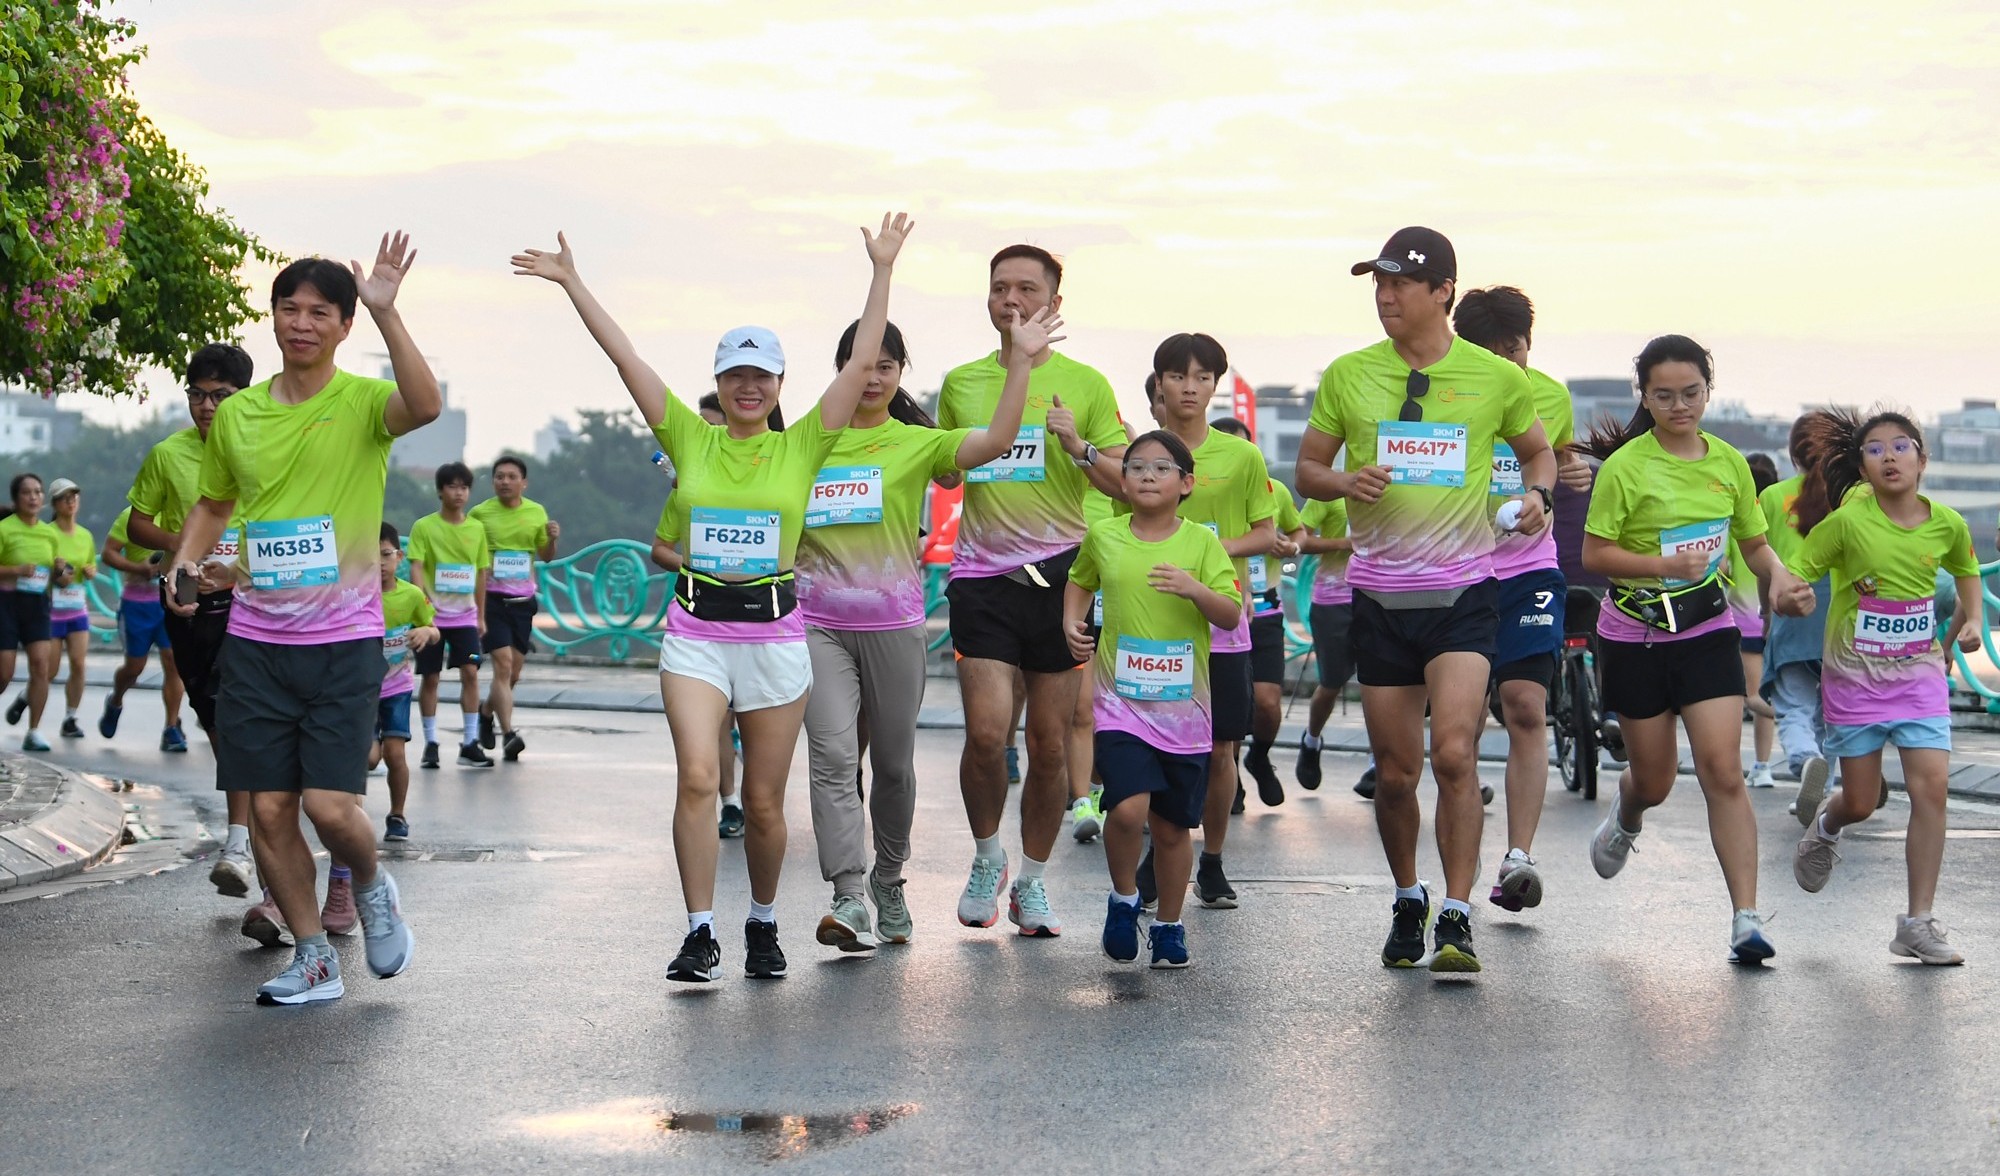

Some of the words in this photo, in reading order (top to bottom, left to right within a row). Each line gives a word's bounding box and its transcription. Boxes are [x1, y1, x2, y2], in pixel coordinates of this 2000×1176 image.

[1433, 428, 1453, 437] 5KM
[1457, 429, 1464, 437] P
[850, 470, 869, 478] 5KM
[814, 482, 869, 499] F6770
[297, 522, 319, 533] 5KM
[322, 521, 330, 530] V
[746, 515, 767, 525] 5KM
[769, 516, 777, 525] V
[705, 527, 765, 545] F6228
[257, 537, 324, 558] M6383
[1863, 614, 1929, 634] F8808
[1166, 645, 1184, 654] 5KM
[1186, 644, 1192, 652] P
[1127, 654, 1183, 673] M6415
